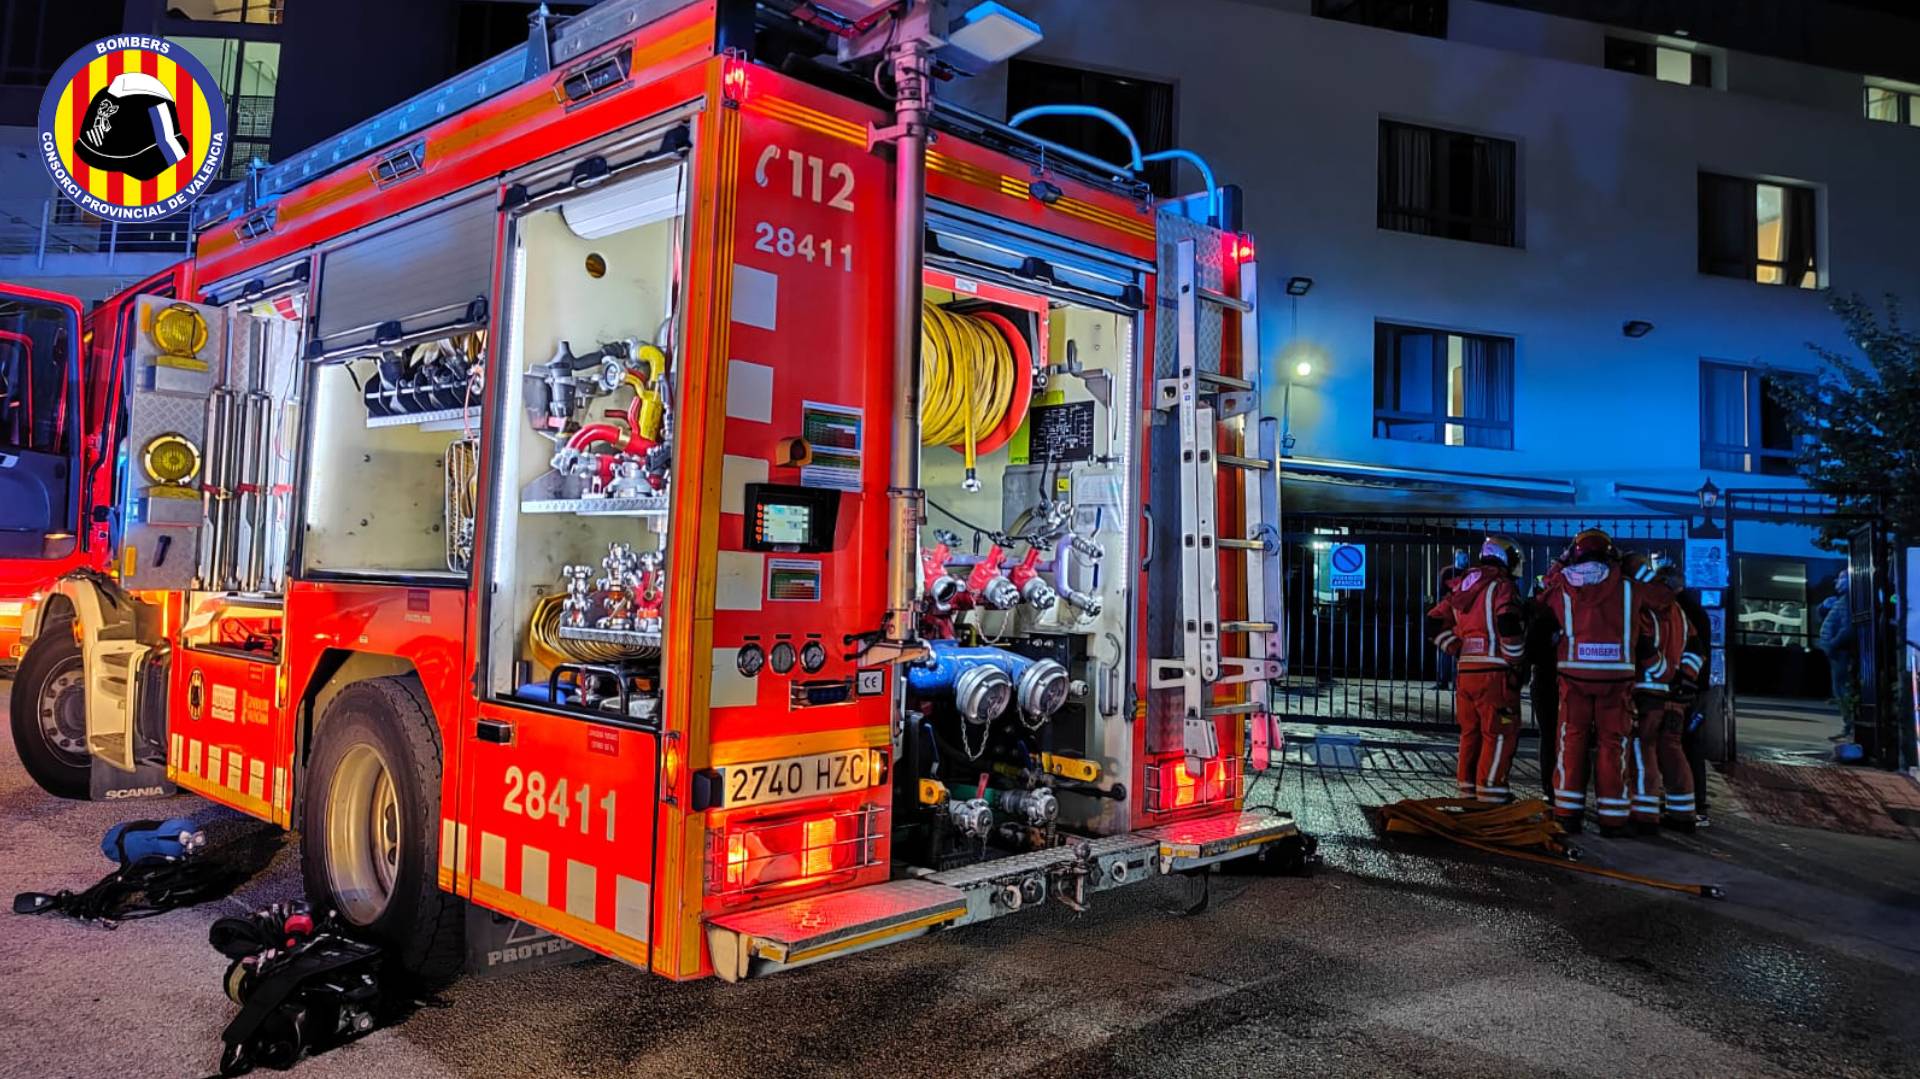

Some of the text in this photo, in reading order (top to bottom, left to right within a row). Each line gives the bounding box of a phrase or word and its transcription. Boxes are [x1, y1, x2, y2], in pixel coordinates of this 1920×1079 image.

[788, 149, 855, 212] 112
[755, 222, 852, 272] 28411
[105, 786, 164, 800] SCANIA
[731, 754, 864, 802] 2740 HZC
[503, 765, 616, 842] 28411
